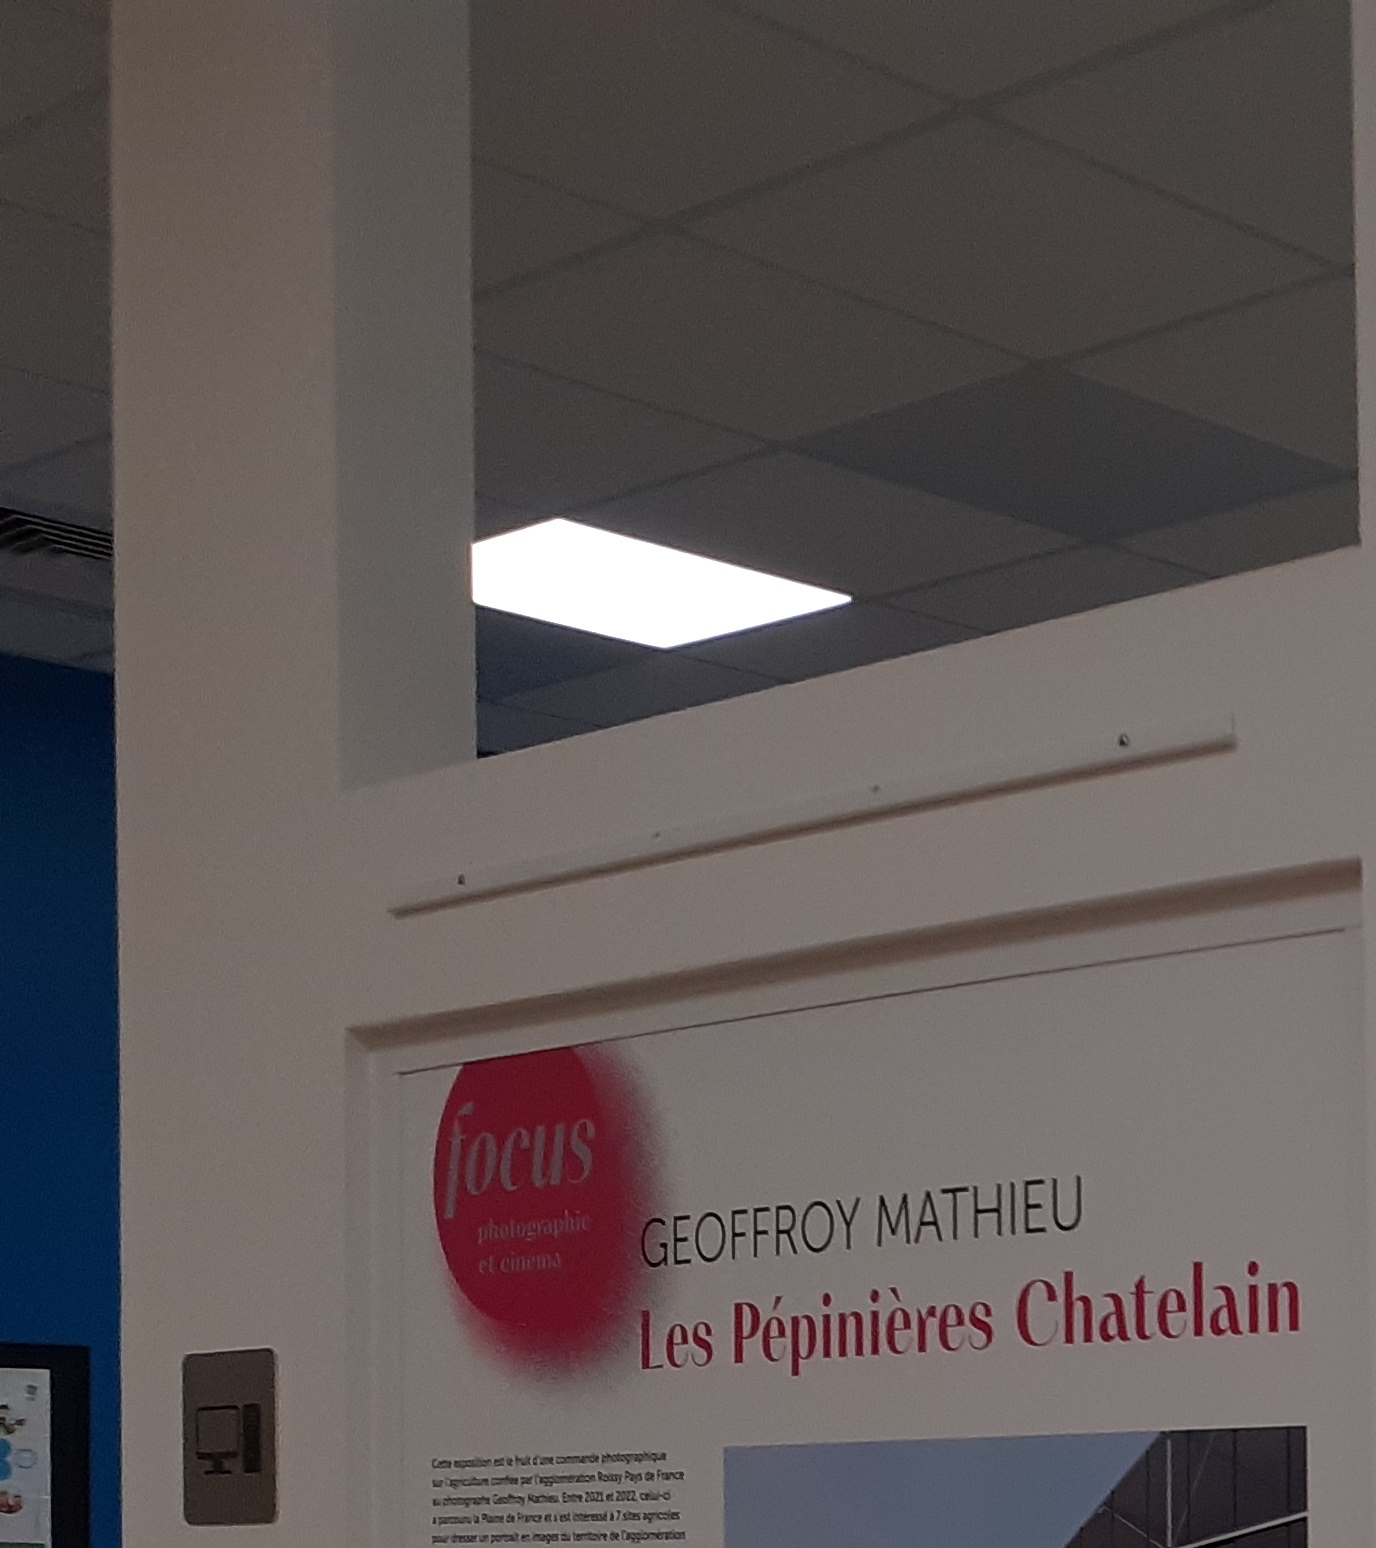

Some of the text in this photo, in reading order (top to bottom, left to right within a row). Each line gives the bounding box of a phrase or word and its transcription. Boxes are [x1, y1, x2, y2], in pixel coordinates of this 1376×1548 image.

[443, 1102, 595, 1219] focus
[478, 1210, 591, 1243] photographie
[479, 1254, 493, 1273] et
[641, 1175, 1085, 1268] GEOFFROY MATHIEU
[640, 1262, 1302, 1376] Les Pépinières Chatelain
